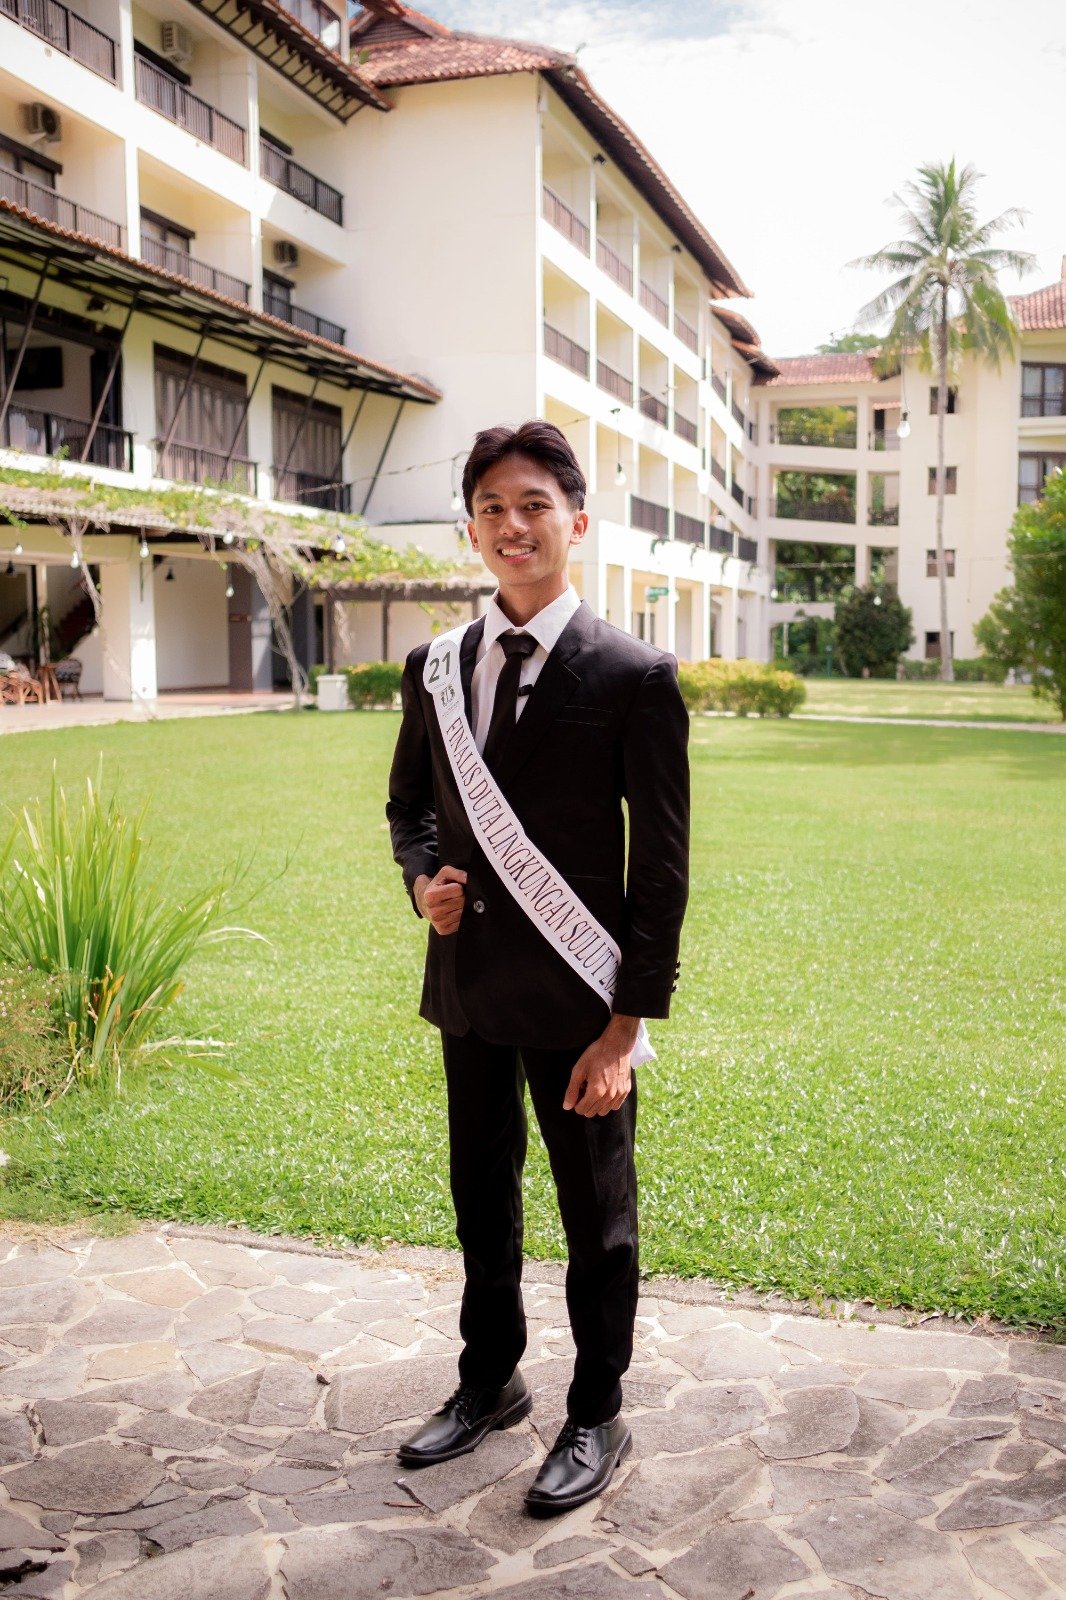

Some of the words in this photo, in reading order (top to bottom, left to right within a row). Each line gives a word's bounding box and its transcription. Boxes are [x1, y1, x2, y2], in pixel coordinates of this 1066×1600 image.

[428, 650, 451, 684] 21
[446, 717, 481, 786] FINALIS
[468, 777, 505, 833] DUTA
[487, 822, 580, 933] LINGKUNGAN
[559, 920, 614, 976] SULUT
